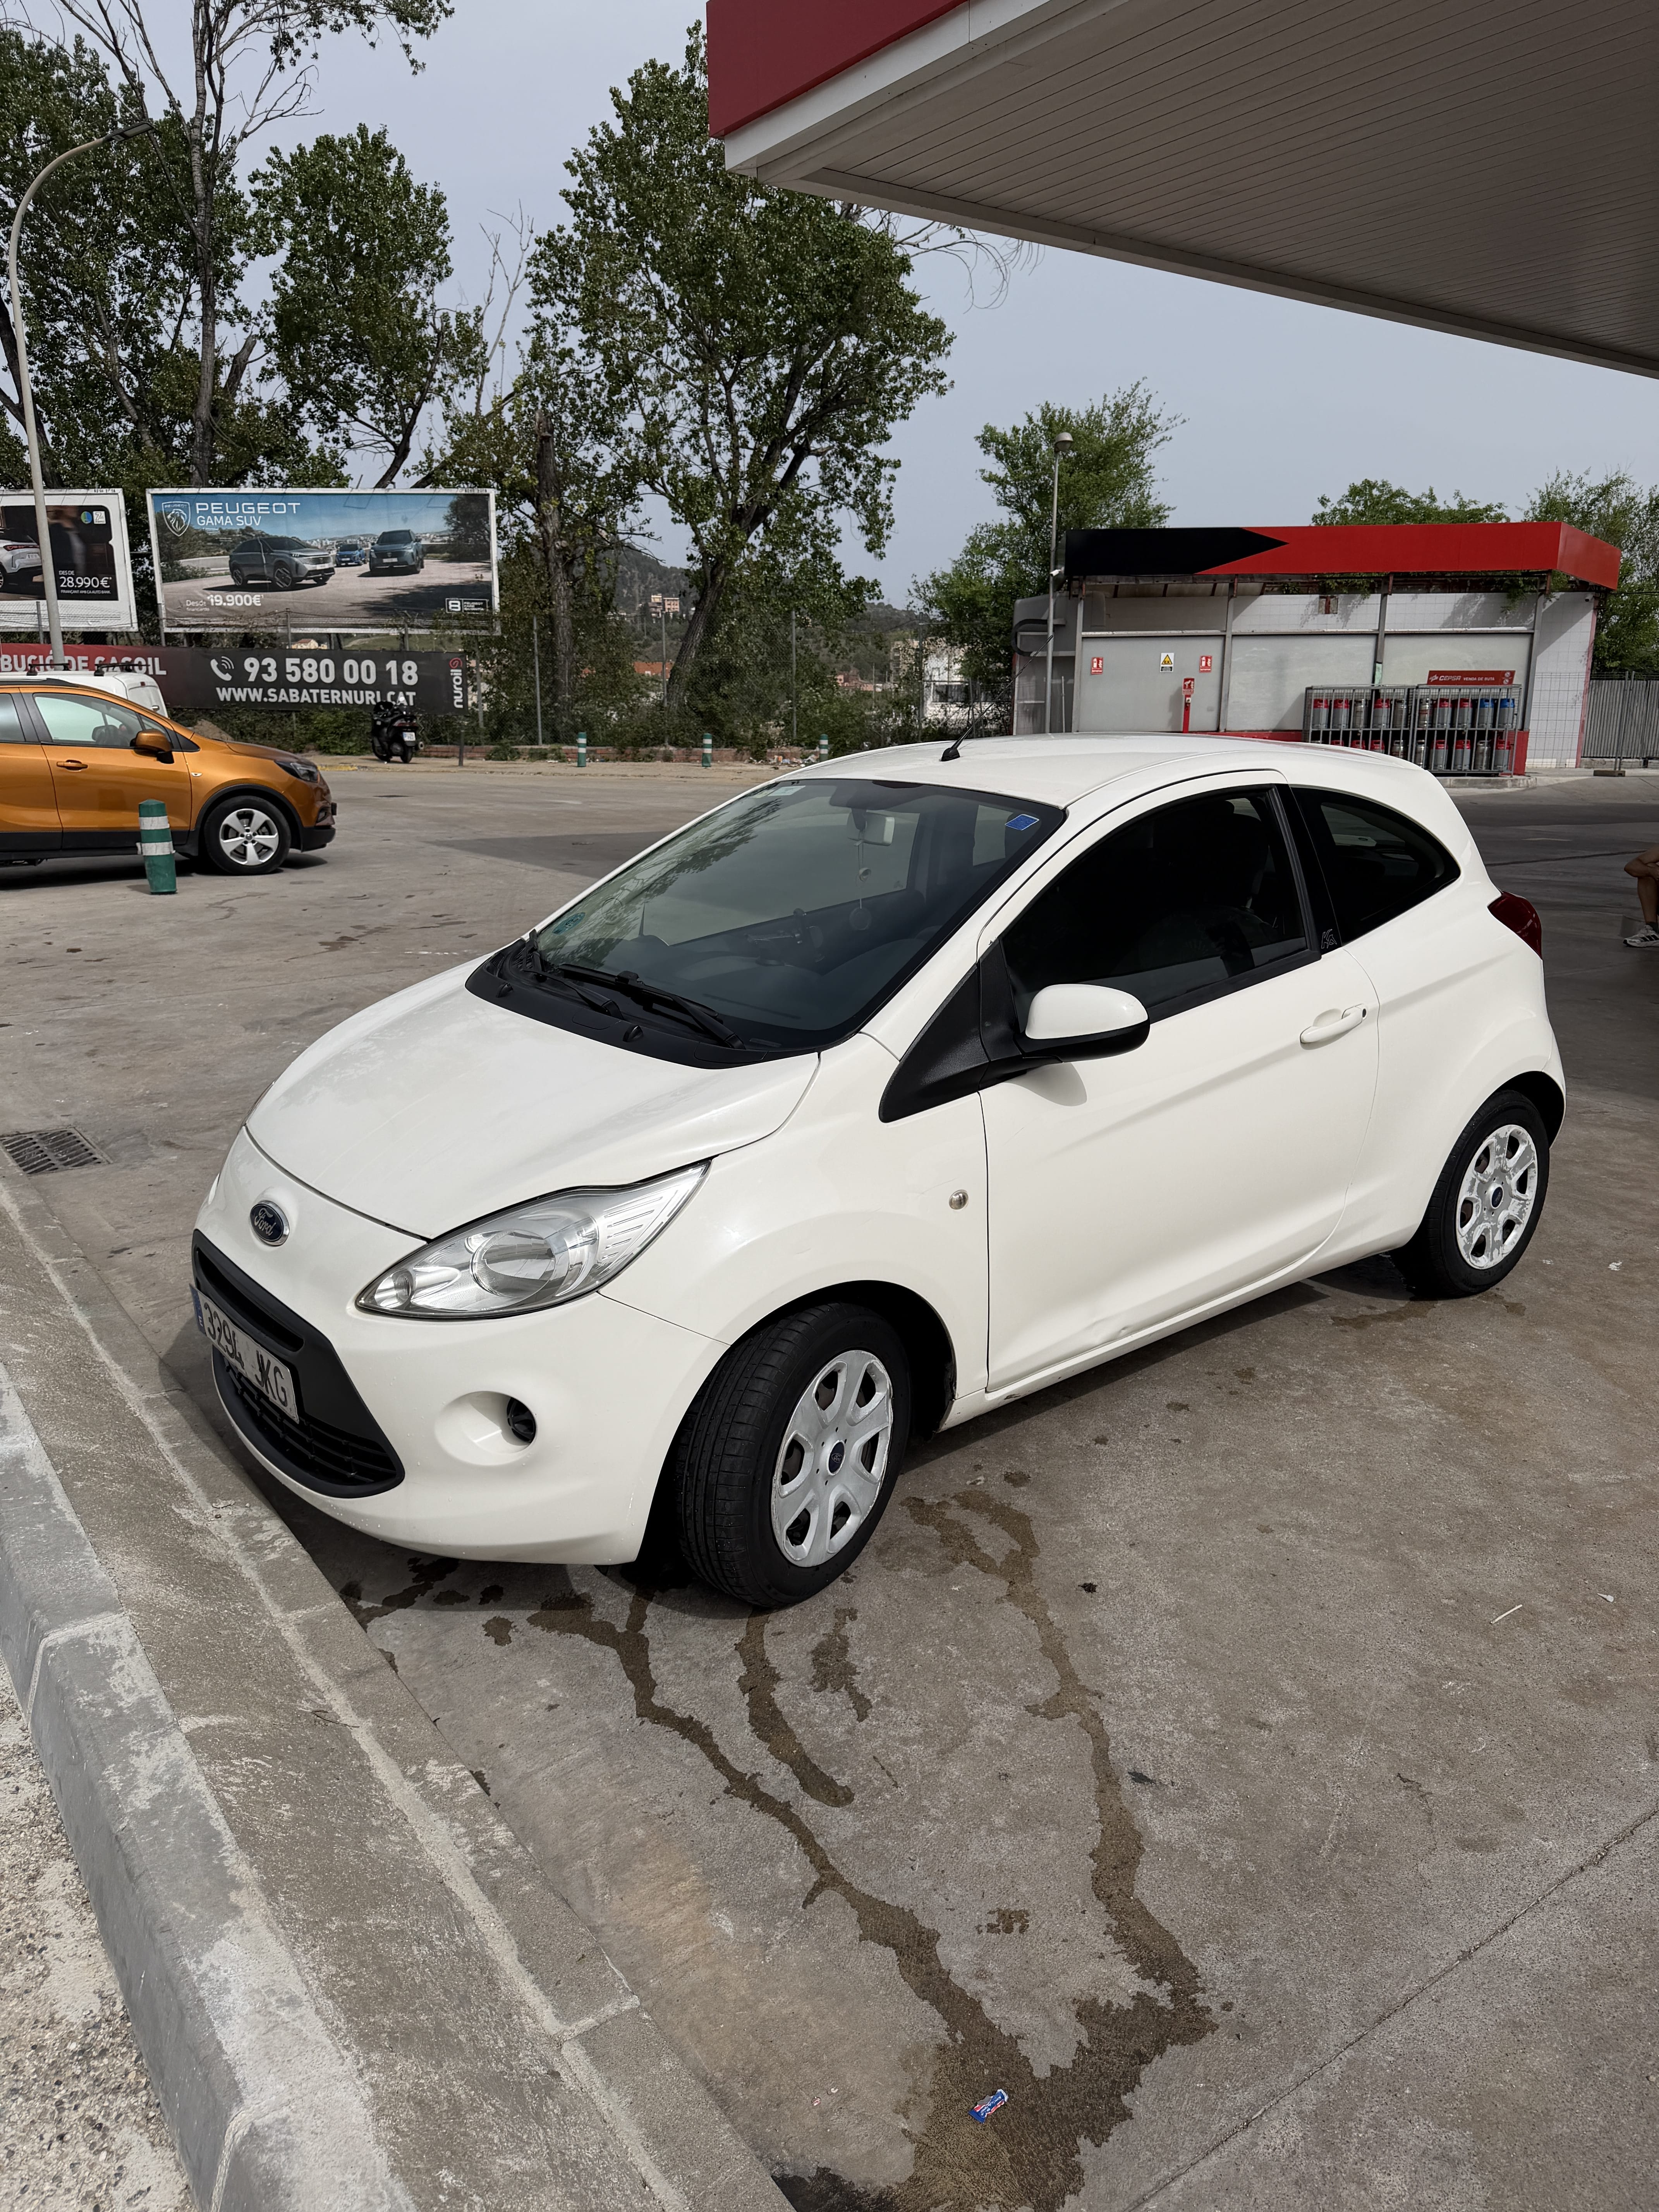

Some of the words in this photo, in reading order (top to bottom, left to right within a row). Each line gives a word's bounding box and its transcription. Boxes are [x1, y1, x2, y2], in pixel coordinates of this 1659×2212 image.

[196, 503, 301, 514] PEUGEOT
[197, 515, 233, 526] GAMA
[236, 515, 261, 526] SUV
[449, 601, 461, 611] 8
[64, 656, 89, 671] DE
[244, 657, 277, 682] 93
[285, 658, 335, 684] 580
[343, 659, 376, 685] 00
[386, 660, 418, 685] 18
[216, 687, 416, 706] WWW.SABATERNURICAT
[450, 669, 464, 708] nuroil
[254, 1207, 276, 1236] Ford
[204, 1302, 245, 1370] 3294
[255, 1350, 288, 1407] JKG
